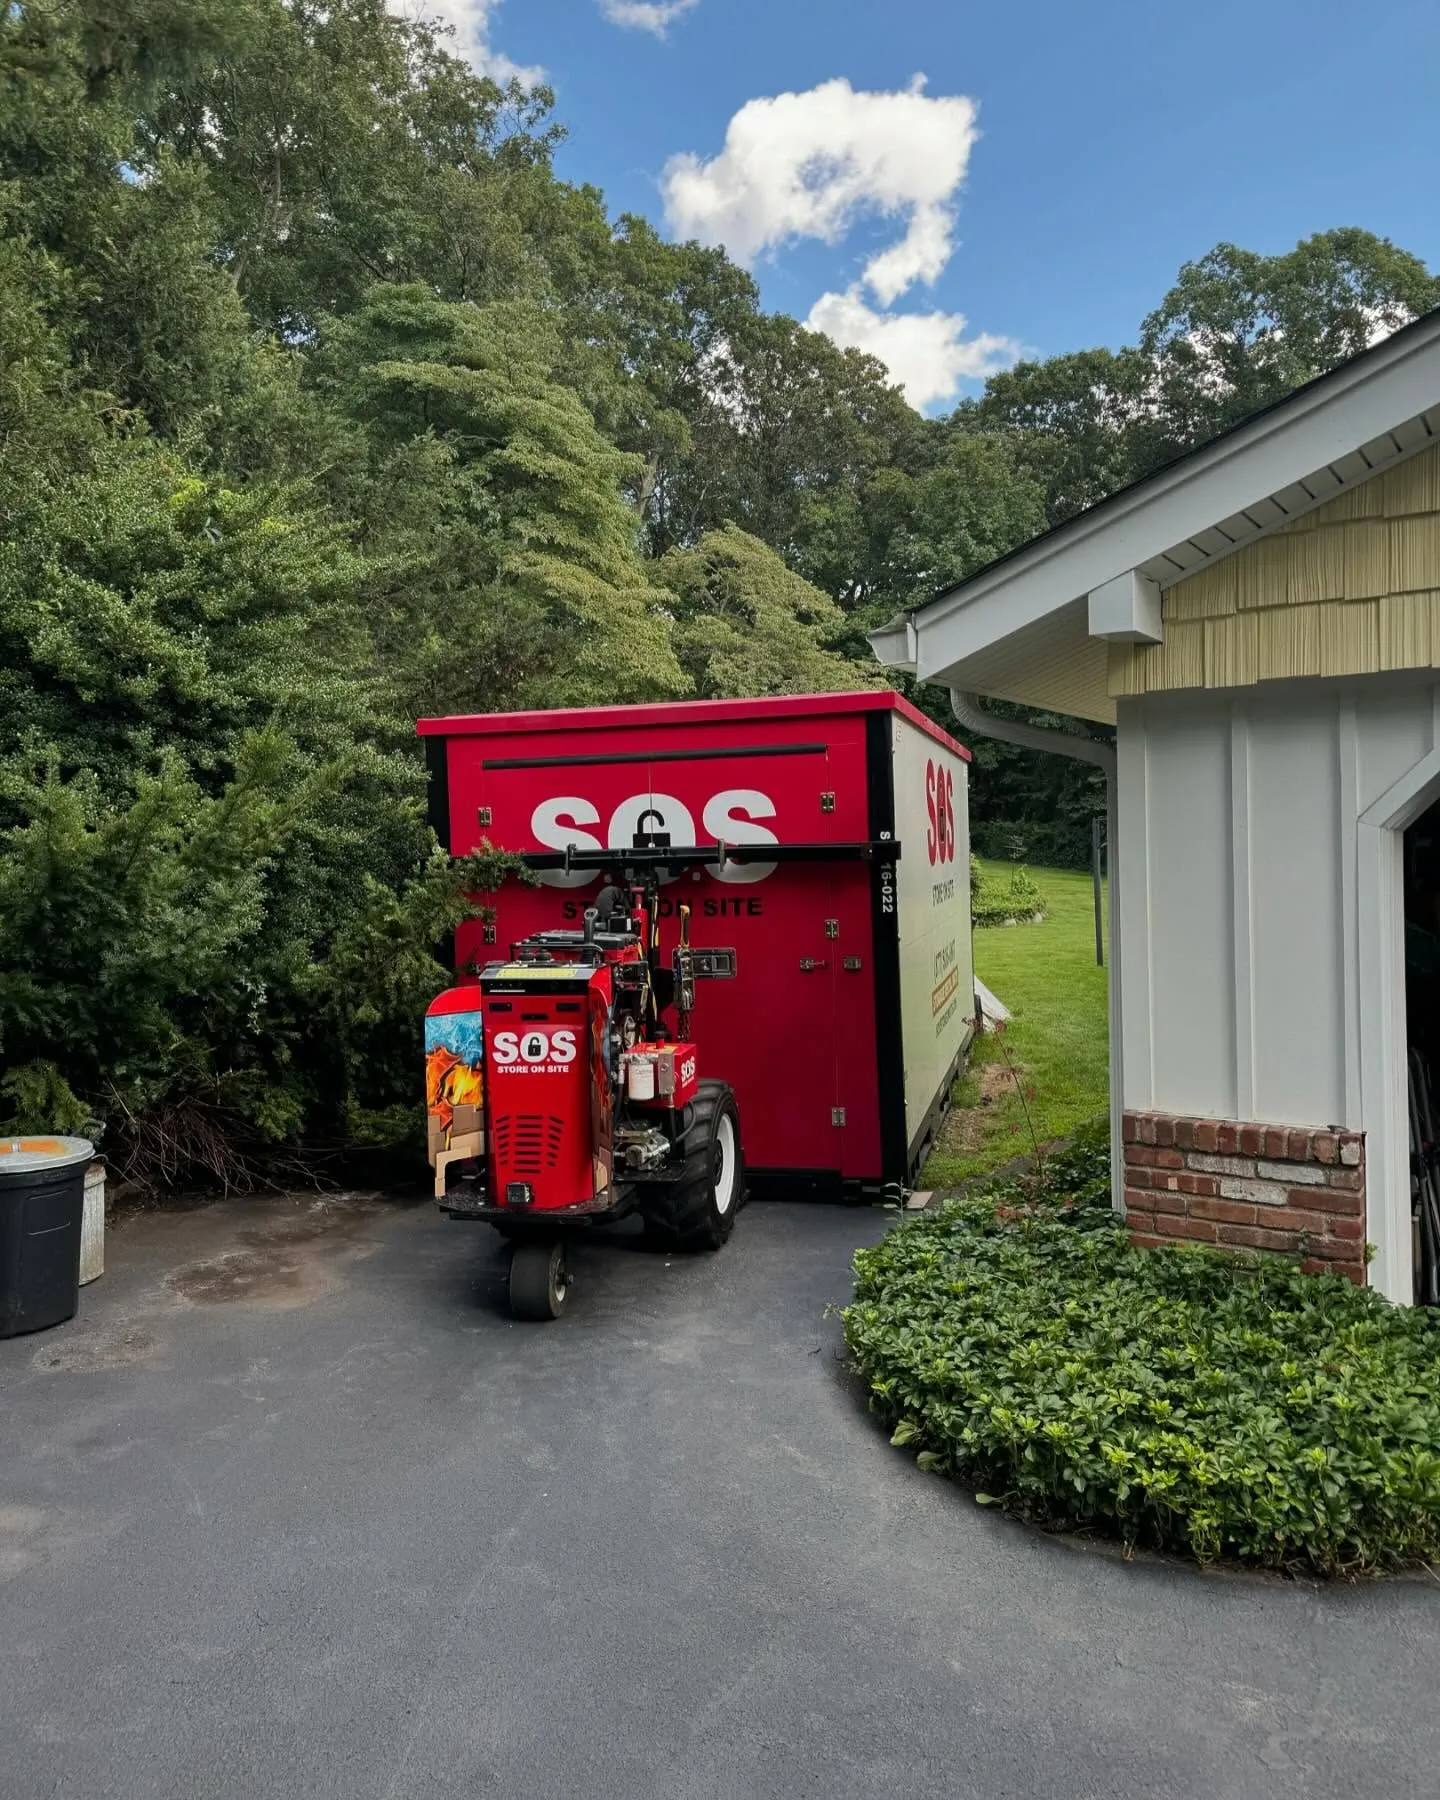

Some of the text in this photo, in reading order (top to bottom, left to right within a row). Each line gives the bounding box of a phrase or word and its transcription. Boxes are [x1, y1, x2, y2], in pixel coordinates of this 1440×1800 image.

[703, 896, 763, 919] SITE
[497, 1064, 570, 1074] STORE ON SITE
